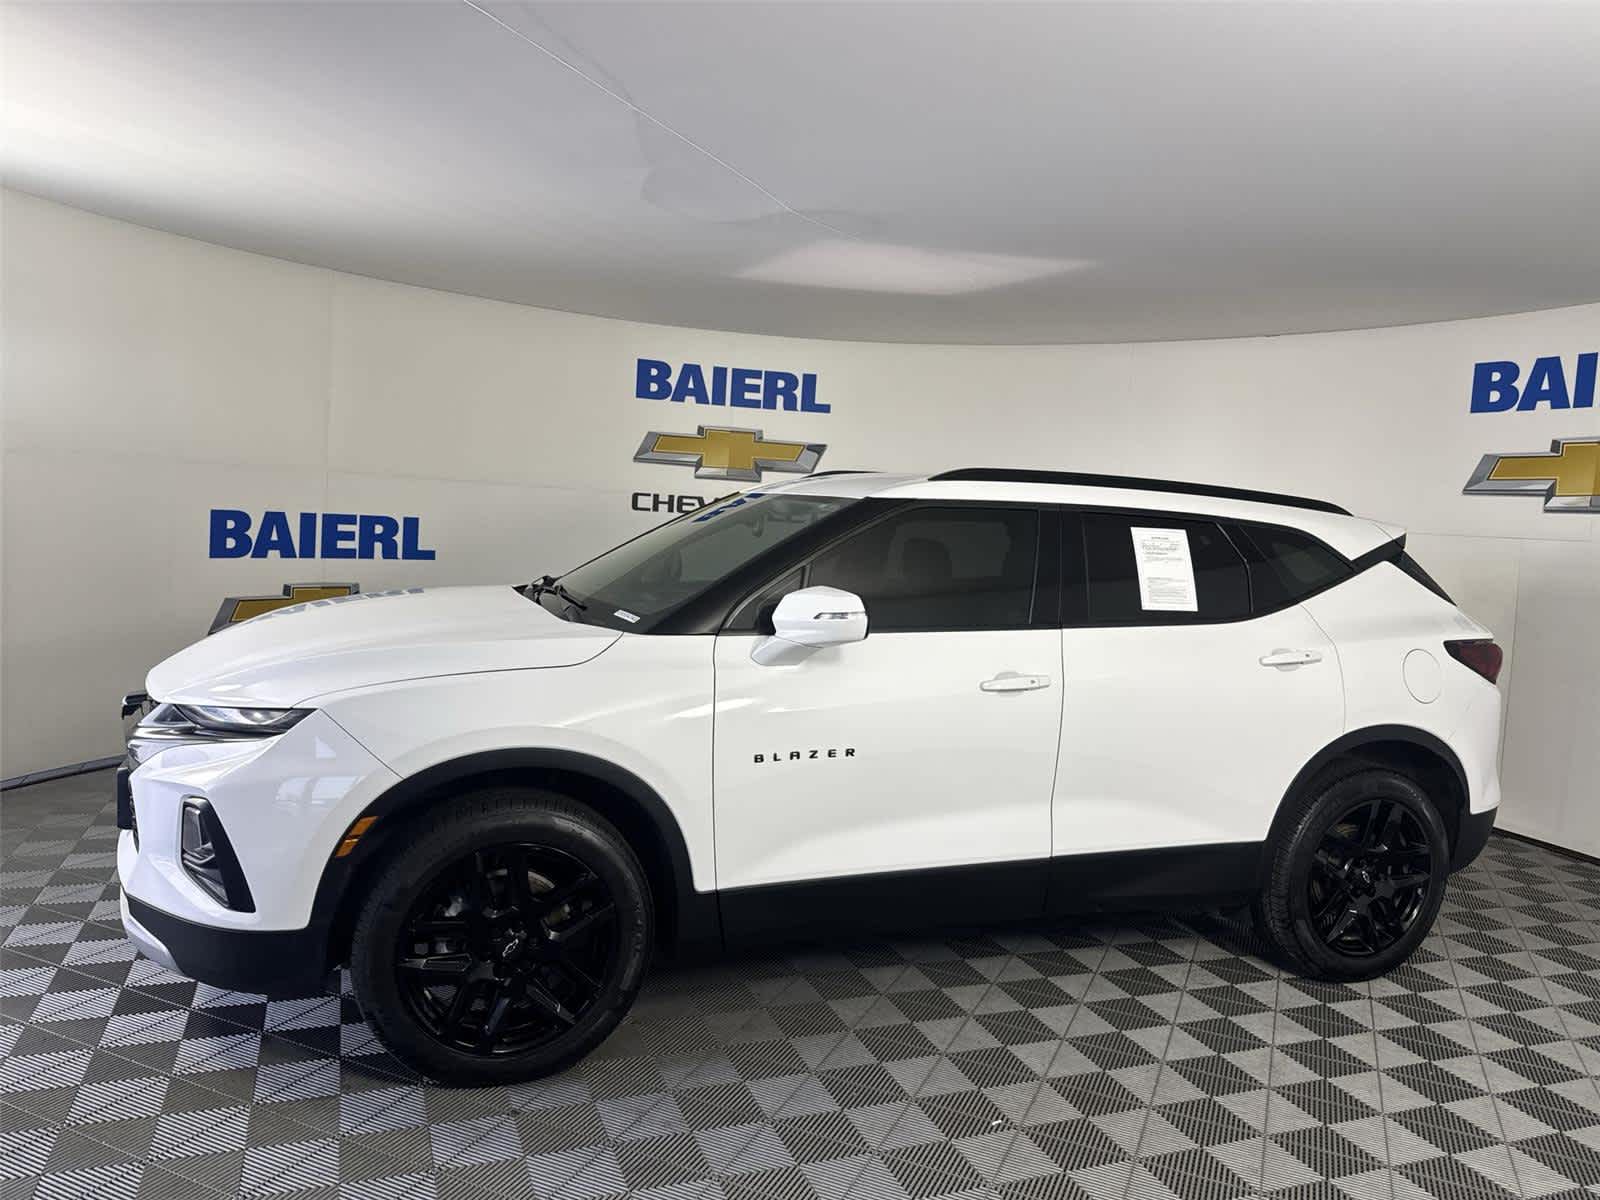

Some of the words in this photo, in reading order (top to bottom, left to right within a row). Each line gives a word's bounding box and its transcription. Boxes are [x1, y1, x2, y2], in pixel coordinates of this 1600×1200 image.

[635, 358, 831, 414] BAIERL
[208, 509, 436, 561] BAIERL
[754, 748, 855, 763] BLAZER
